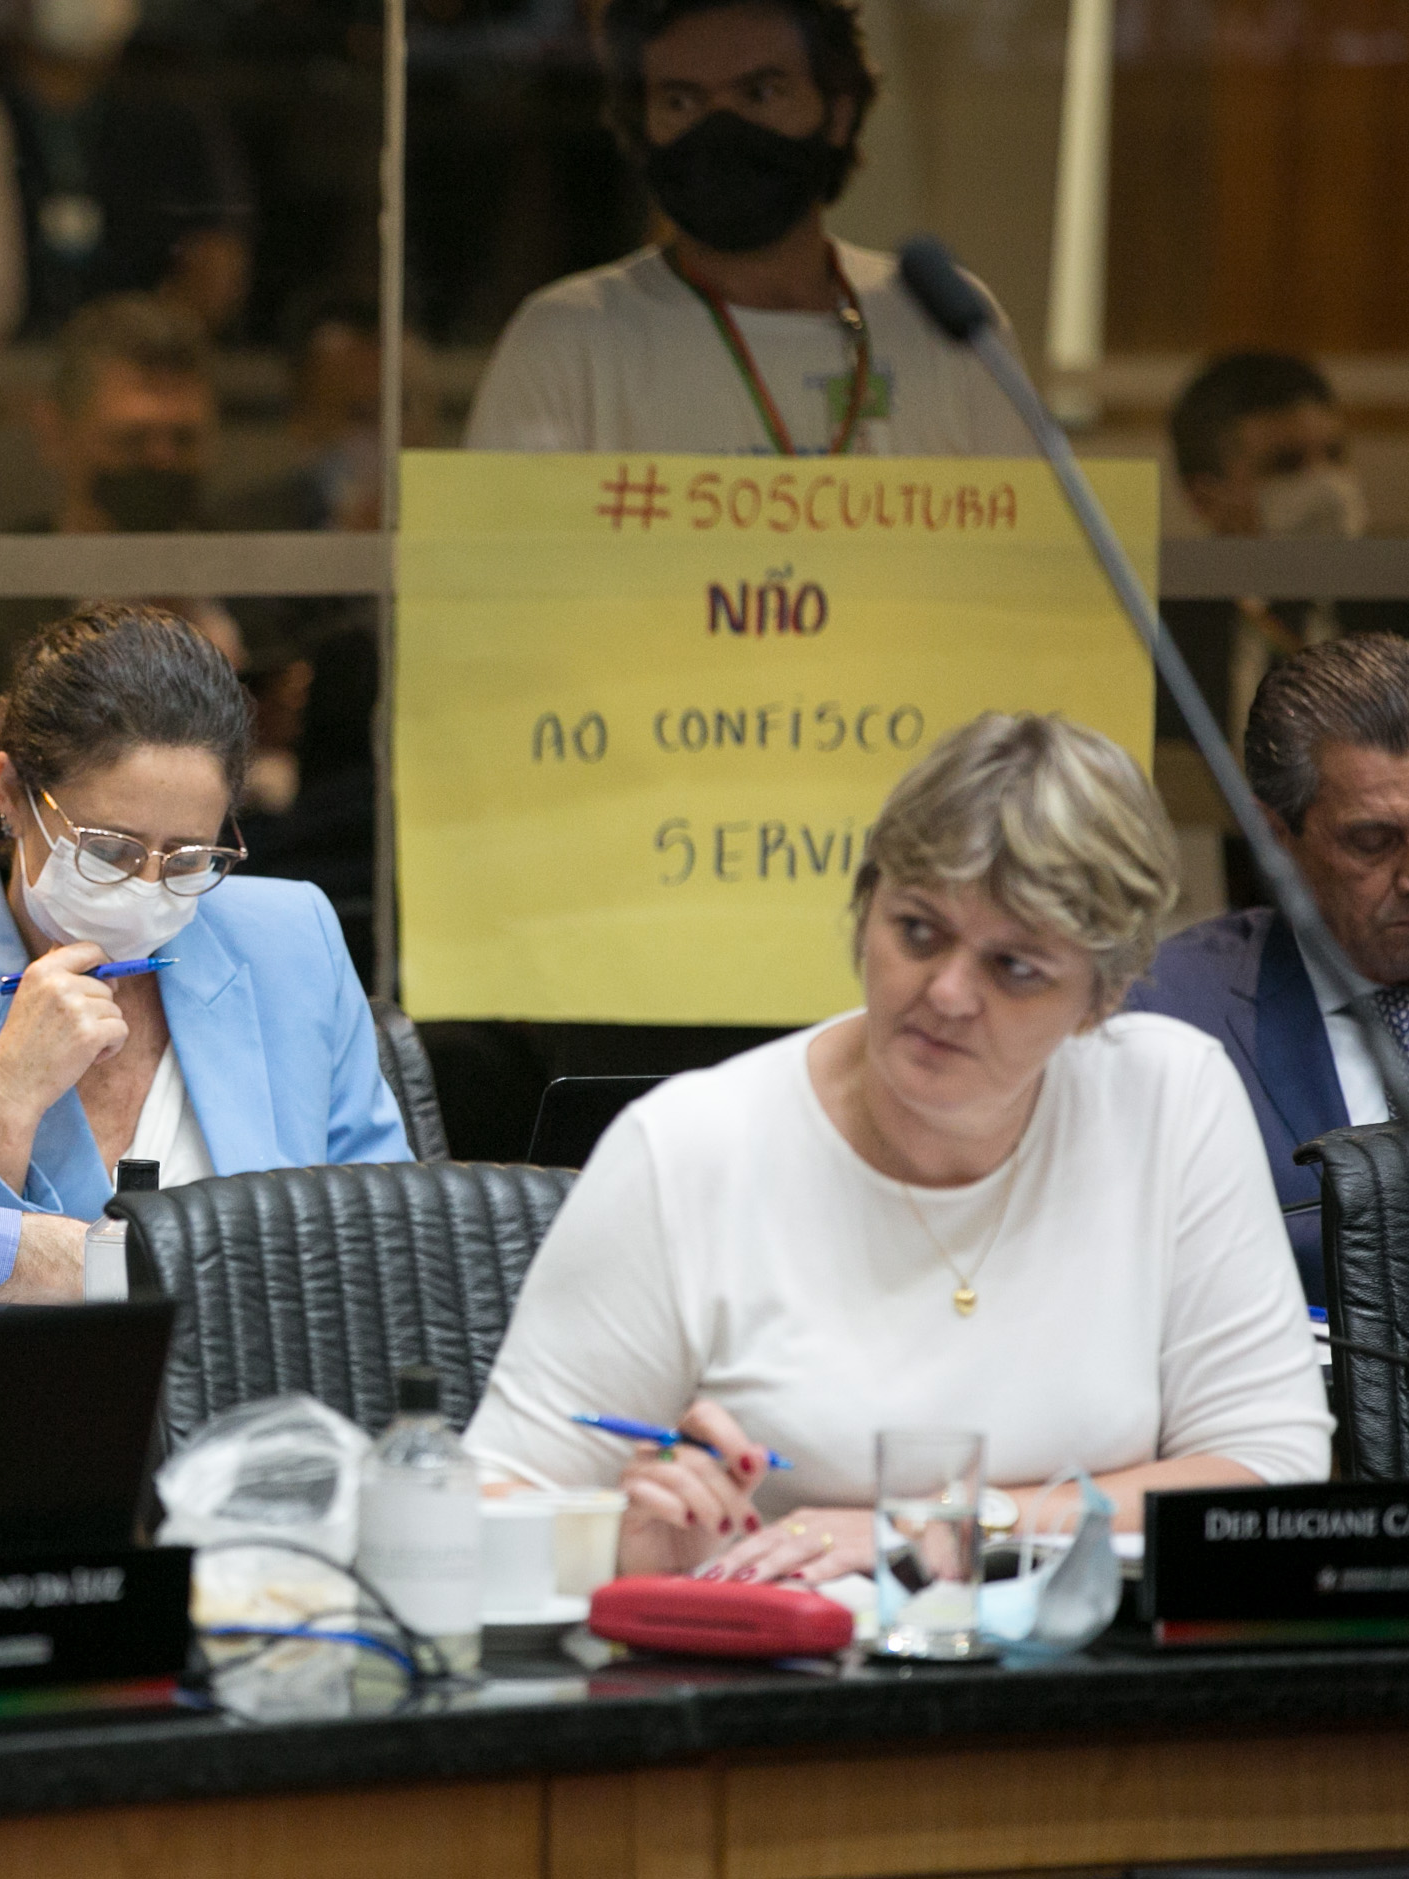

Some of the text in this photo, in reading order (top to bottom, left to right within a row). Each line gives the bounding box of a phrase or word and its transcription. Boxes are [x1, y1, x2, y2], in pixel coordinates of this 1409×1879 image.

[596, 462, 1018, 534] #SOSCULTURA
[706, 564, 830, 638] NÃO
[531, 693, 926, 765] AO CONFISCO
[654, 816, 873, 887] SERVI
